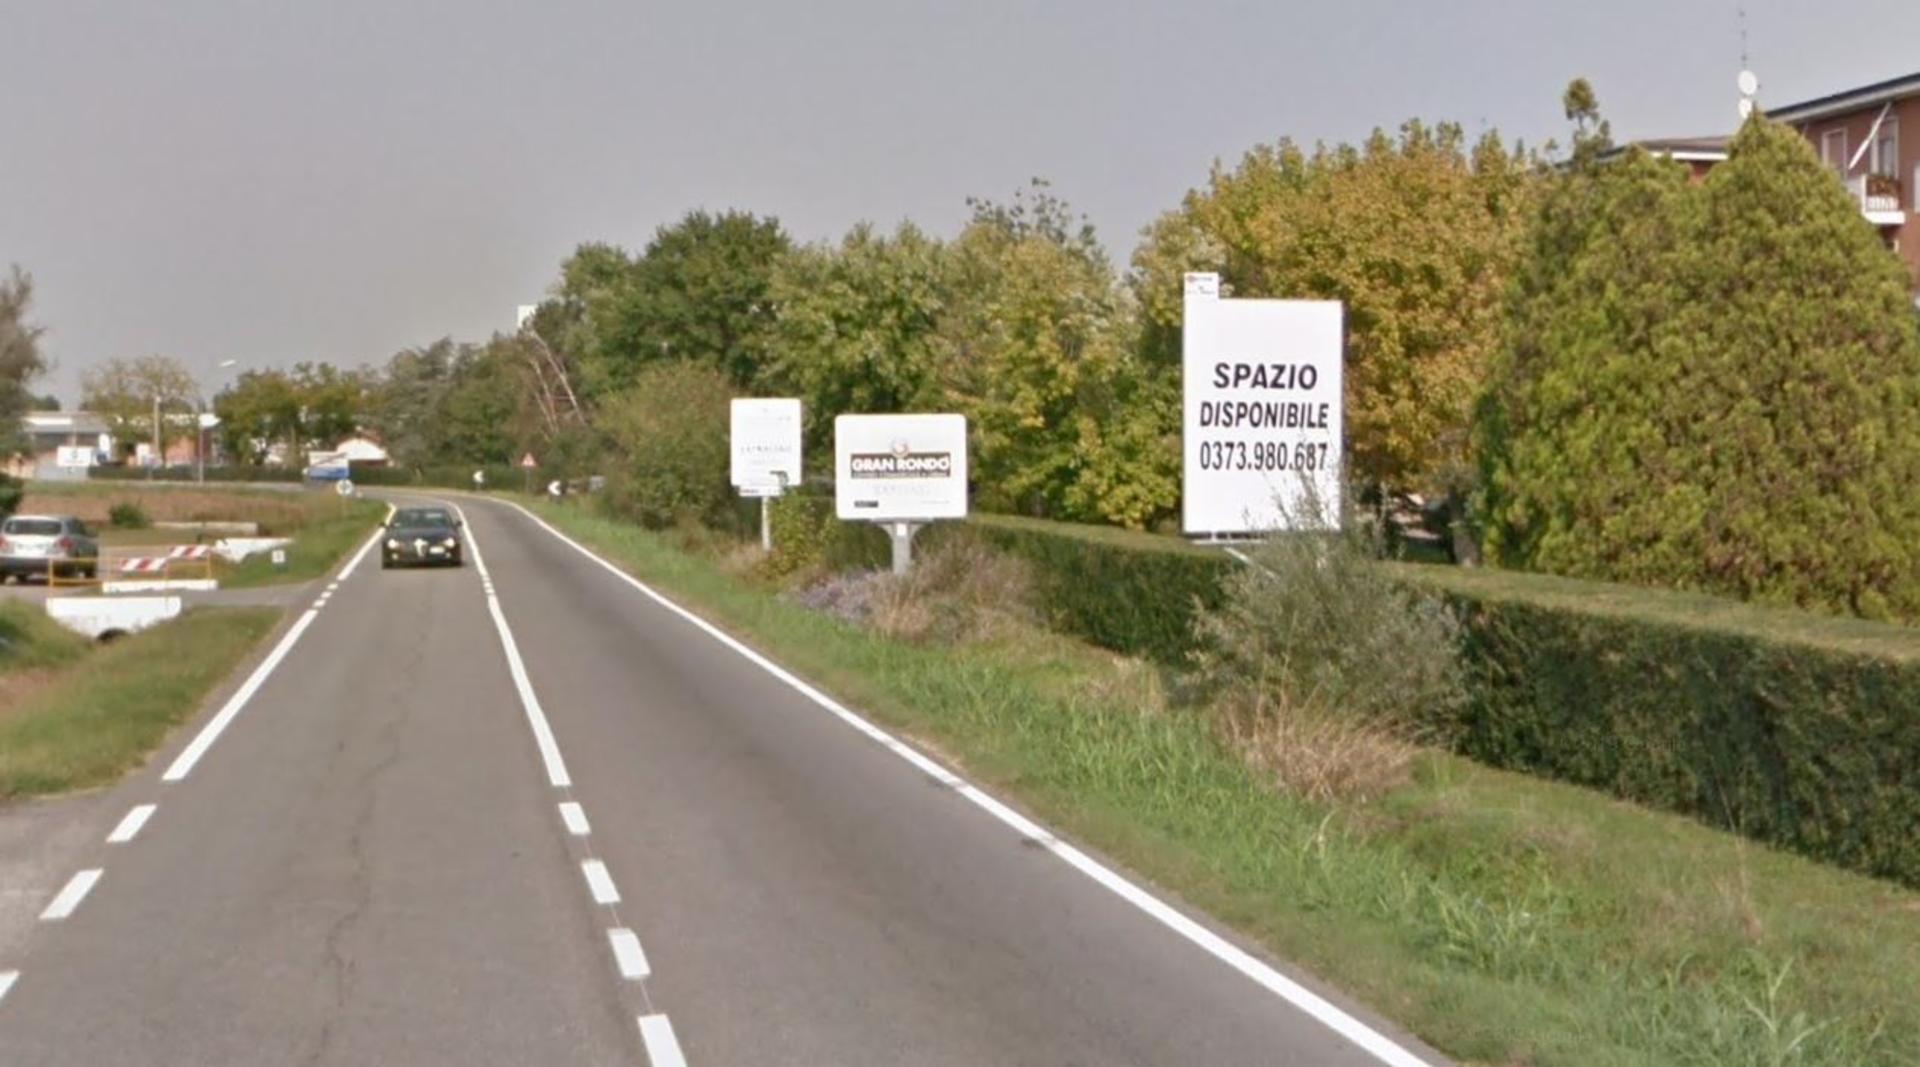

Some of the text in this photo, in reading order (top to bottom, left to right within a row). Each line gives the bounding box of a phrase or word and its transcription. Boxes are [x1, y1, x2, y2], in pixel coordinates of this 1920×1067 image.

[1213, 362, 1318, 390] SPAZIO
[1200, 401, 1329, 429] DISPONIBILE
[852, 457, 894, 471] GRAN
[1200, 441, 1328, 471] 0373.980.687
